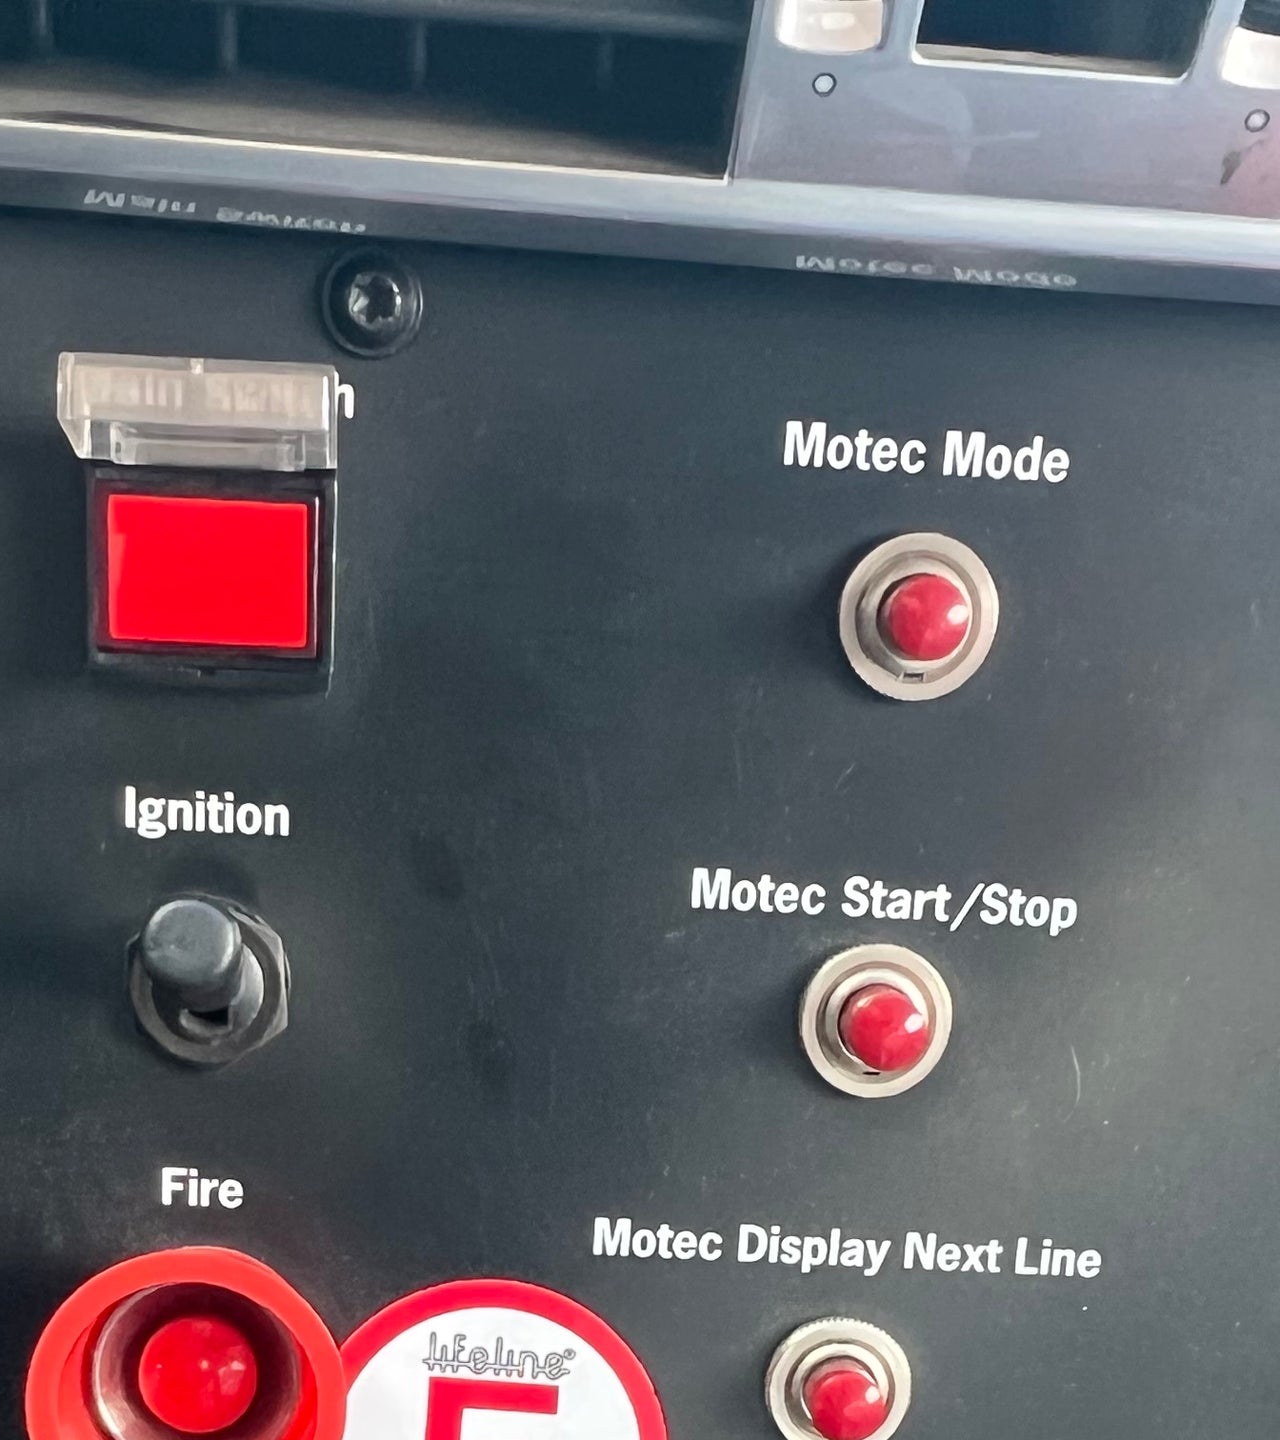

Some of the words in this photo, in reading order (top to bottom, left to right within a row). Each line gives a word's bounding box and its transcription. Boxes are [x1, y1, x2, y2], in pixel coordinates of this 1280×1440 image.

[783, 420, 927, 474] Motec
[942, 430, 1070, 483] Mode
[124, 785, 290, 839] Ignition
[691, 867, 826, 915] Motec
[841, 875, 1078, 937] Start/Stop
[161, 1166, 244, 1209] Fire
[592, 1216, 723, 1261] Motec
[737, 1223, 888, 1277] Display
[903, 1231, 1004, 1274] Next
[1014, 1236, 1102, 1279] Line
